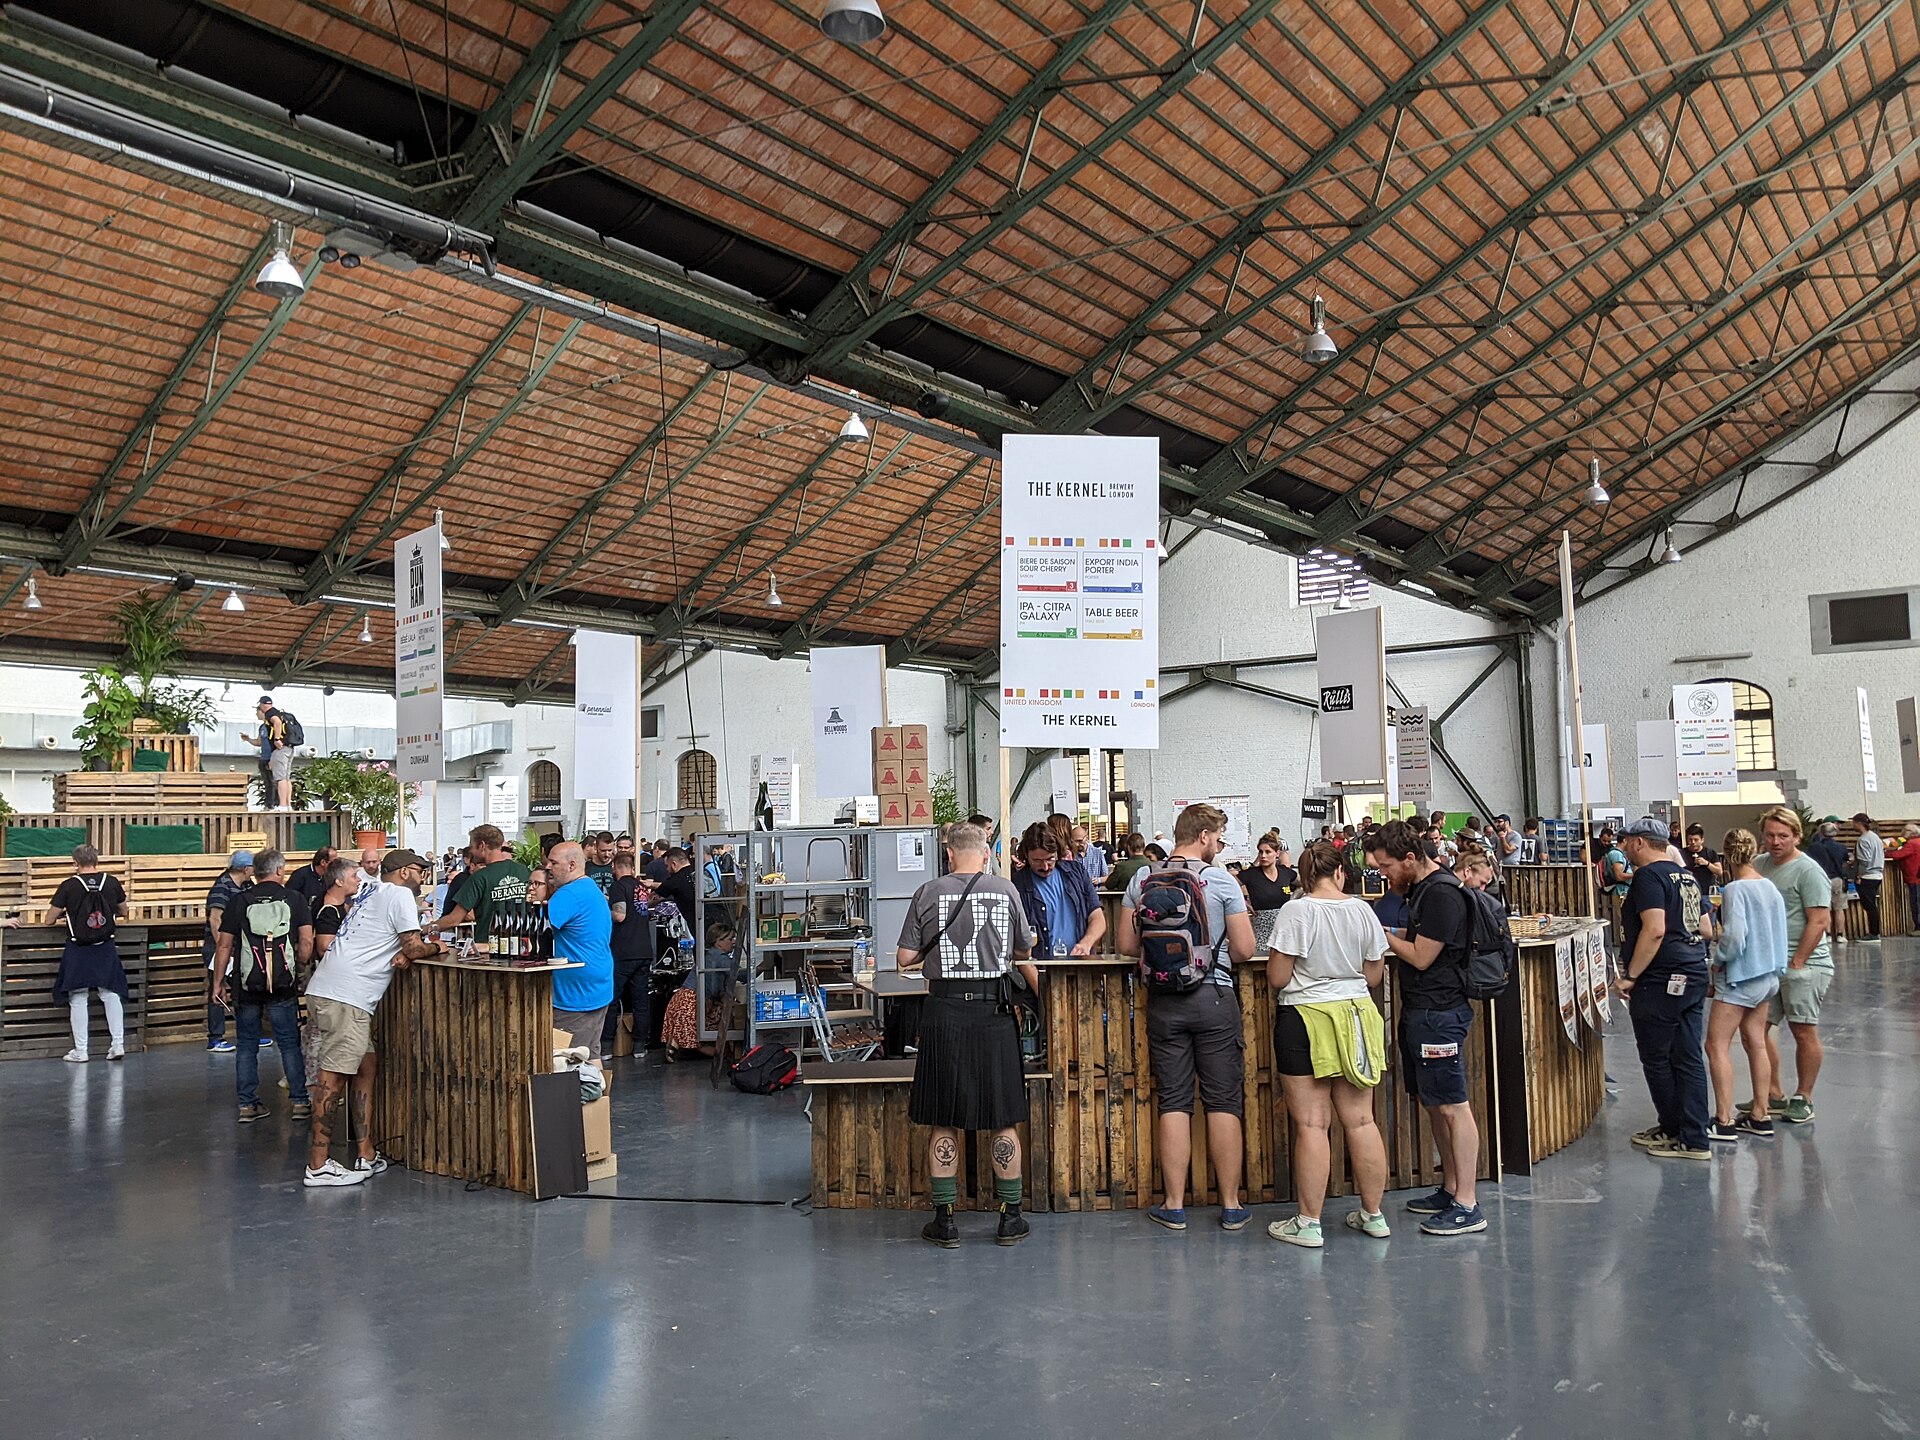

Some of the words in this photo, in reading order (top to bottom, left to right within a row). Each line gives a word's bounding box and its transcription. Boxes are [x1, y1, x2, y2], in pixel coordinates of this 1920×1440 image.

[1028, 482, 1051, 496] THE
[1056, 482, 1106, 498] KERNEL
[1020, 602, 1034, 610] IPA
[1044, 602, 1071, 611] CITRA
[1020, 612, 1060, 620] GALAXY
[1085, 608, 1112, 617] TABLE
[1116, 609, 1138, 617] BEER
[1042, 715, 1064, 725] THE
[1070, 715, 1117, 726] KERNEL
[410, 754, 429, 765] DUNHAM
[491, 890, 503, 898] DE
[503, 886, 526, 897] RANKE
